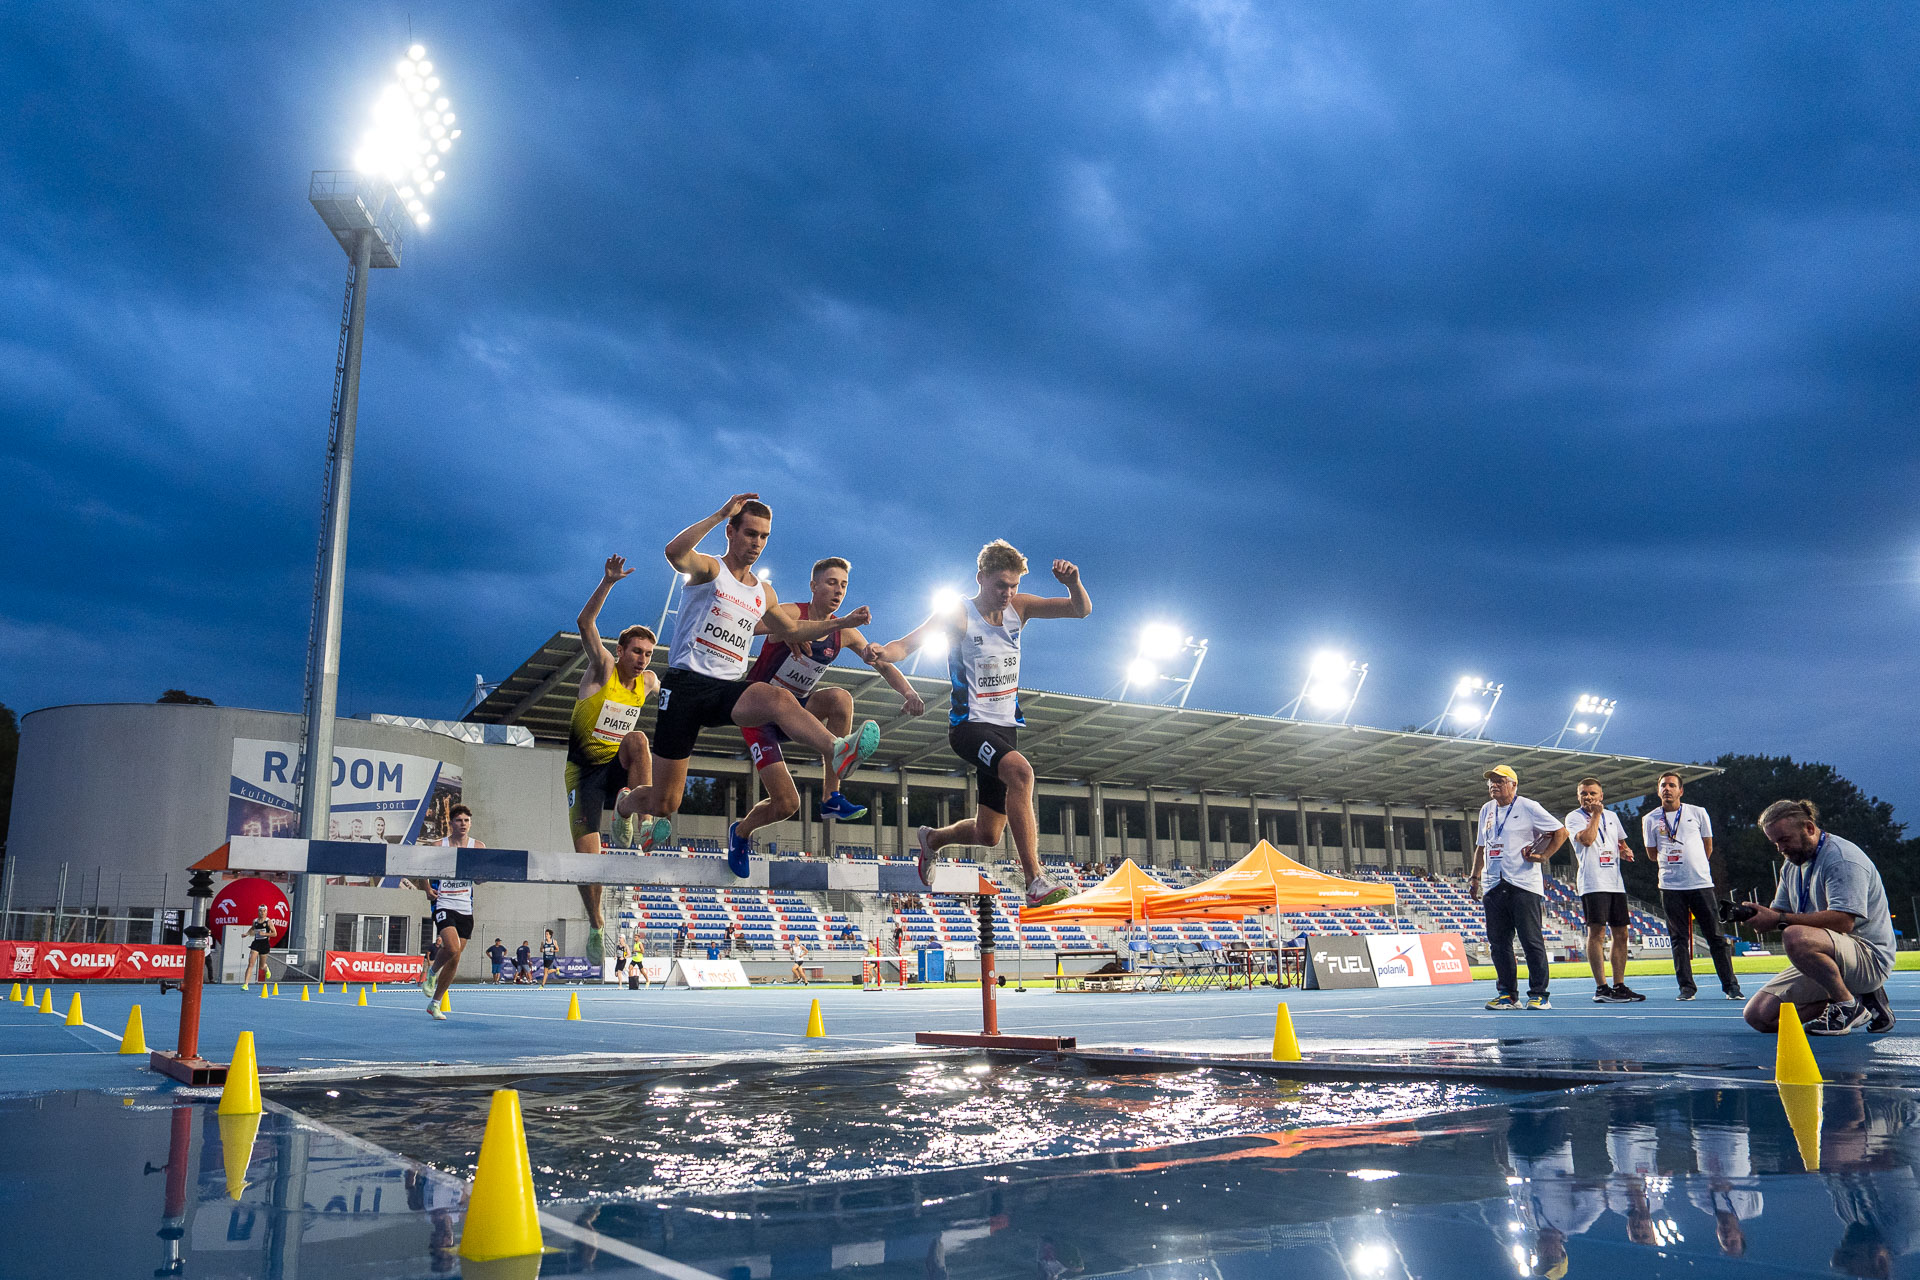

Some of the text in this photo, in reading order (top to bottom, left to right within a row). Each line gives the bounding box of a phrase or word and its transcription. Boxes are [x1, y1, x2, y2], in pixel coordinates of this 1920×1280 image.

[737, 618, 753, 632] 476
[704, 622, 746, 650] PORADA
[706, 648, 725, 659] RADOM
[1003, 656, 1017, 667] 583
[786, 669, 816, 686] JANTA
[978, 674, 1018, 687] GRZEŚKOWIAK
[625, 708, 638, 718] 652
[603, 716, 632, 731] PIĄTEK
[980, 745, 993, 762] 10
[240, 786, 289, 808] kultura
[376, 801, 405, 811] sport
[215, 917, 239, 925] ORLEN
[1648, 937, 1670, 948] RADO
[70, 953, 116, 968] ORLEN
[151, 954, 187, 968] ORLE
[352, 960, 385, 972] ORLE
[1327, 955, 1371, 974] FUEL
[1435, 961, 1460, 971] ORLEN
[708, 969, 737, 983] mosir
[1377, 963, 1406, 977] polanik
